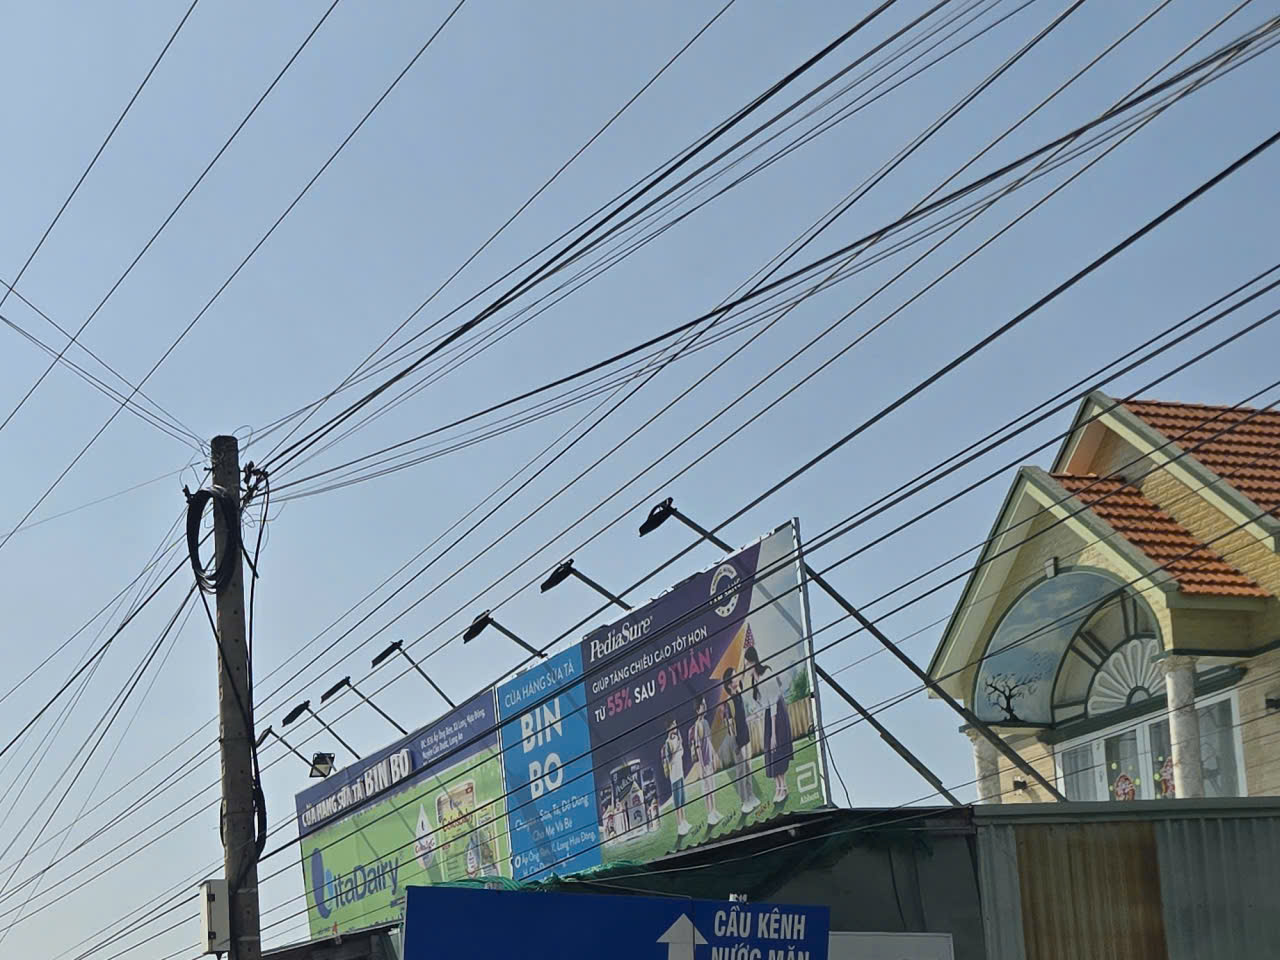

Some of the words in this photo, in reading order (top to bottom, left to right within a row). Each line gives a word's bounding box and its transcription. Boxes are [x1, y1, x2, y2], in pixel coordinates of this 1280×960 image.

[589, 620, 650, 663] PediaSure
[653, 645, 672, 663] CAO
[606, 687, 633, 717] 55%
[634, 680, 656, 704] SAU
[657, 670, 668, 692] 9
[521, 696, 563, 754] BIN
[364, 757, 391, 797] BIN
[390, 748, 412, 785] BO
[528, 752, 564, 801] BO
[714, 905, 751, 939] CẦU
[758, 908, 806, 941] KÊNH
